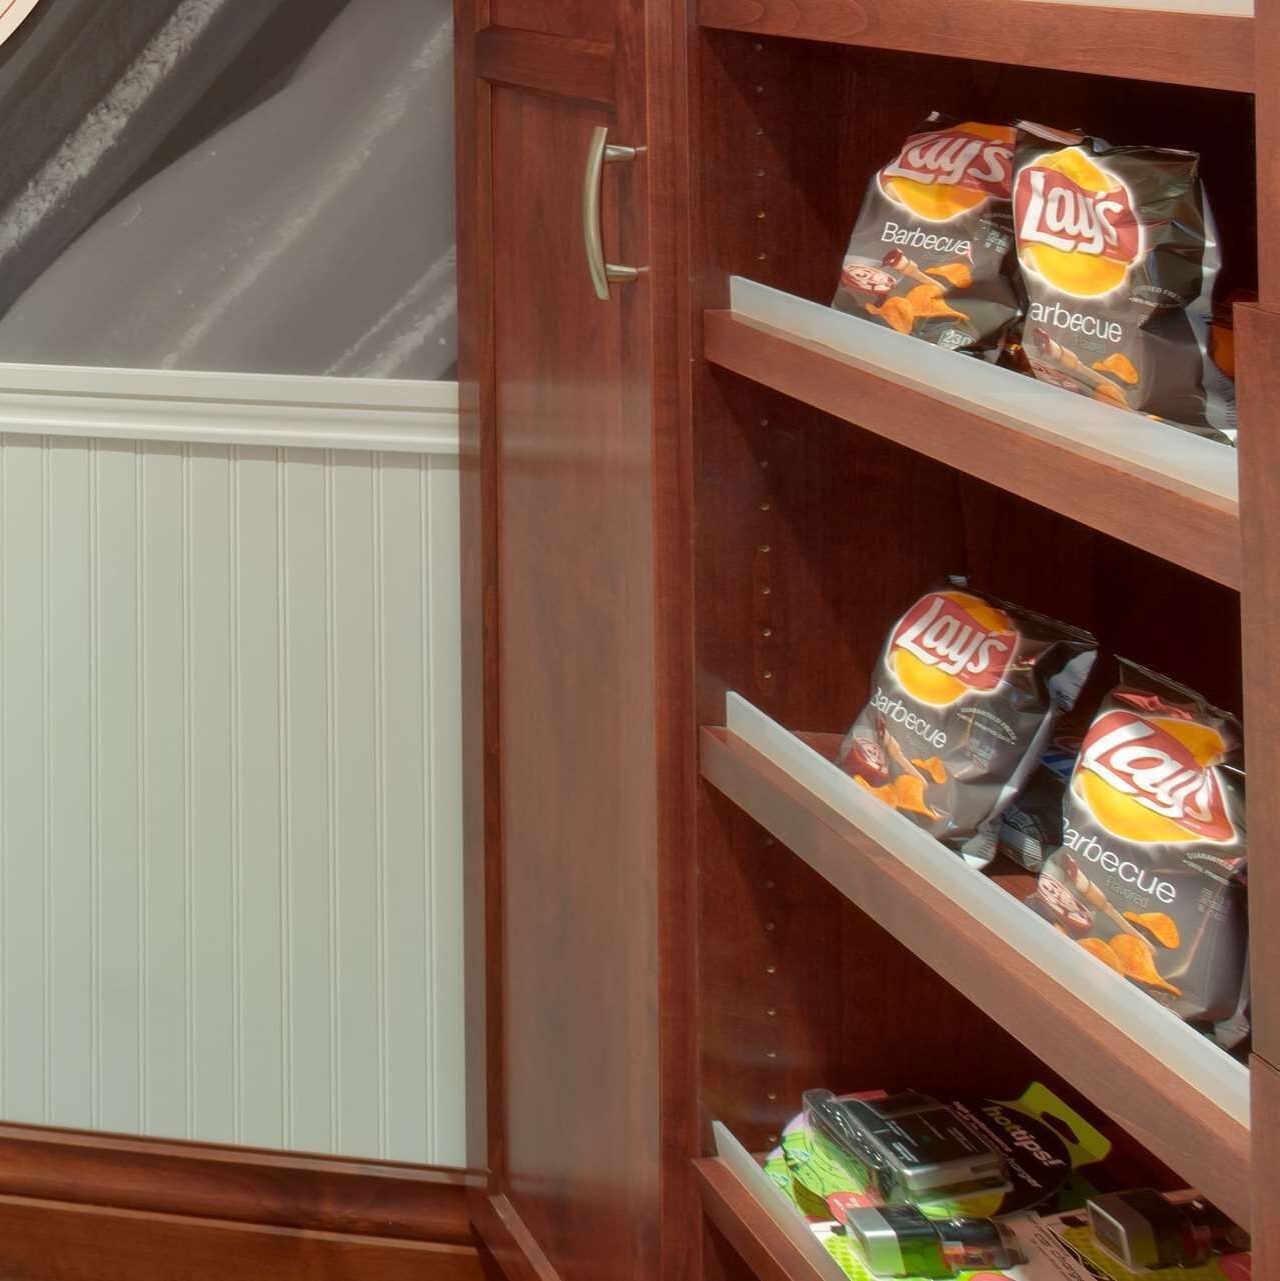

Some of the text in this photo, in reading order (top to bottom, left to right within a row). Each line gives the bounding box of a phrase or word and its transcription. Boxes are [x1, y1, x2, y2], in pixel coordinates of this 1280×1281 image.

[883, 134, 1014, 188] Lay's
[881, 221, 972, 257] Barbecue
[1018, 169, 1124, 256] Lay's
[895, 597, 1010, 677] Lay's
